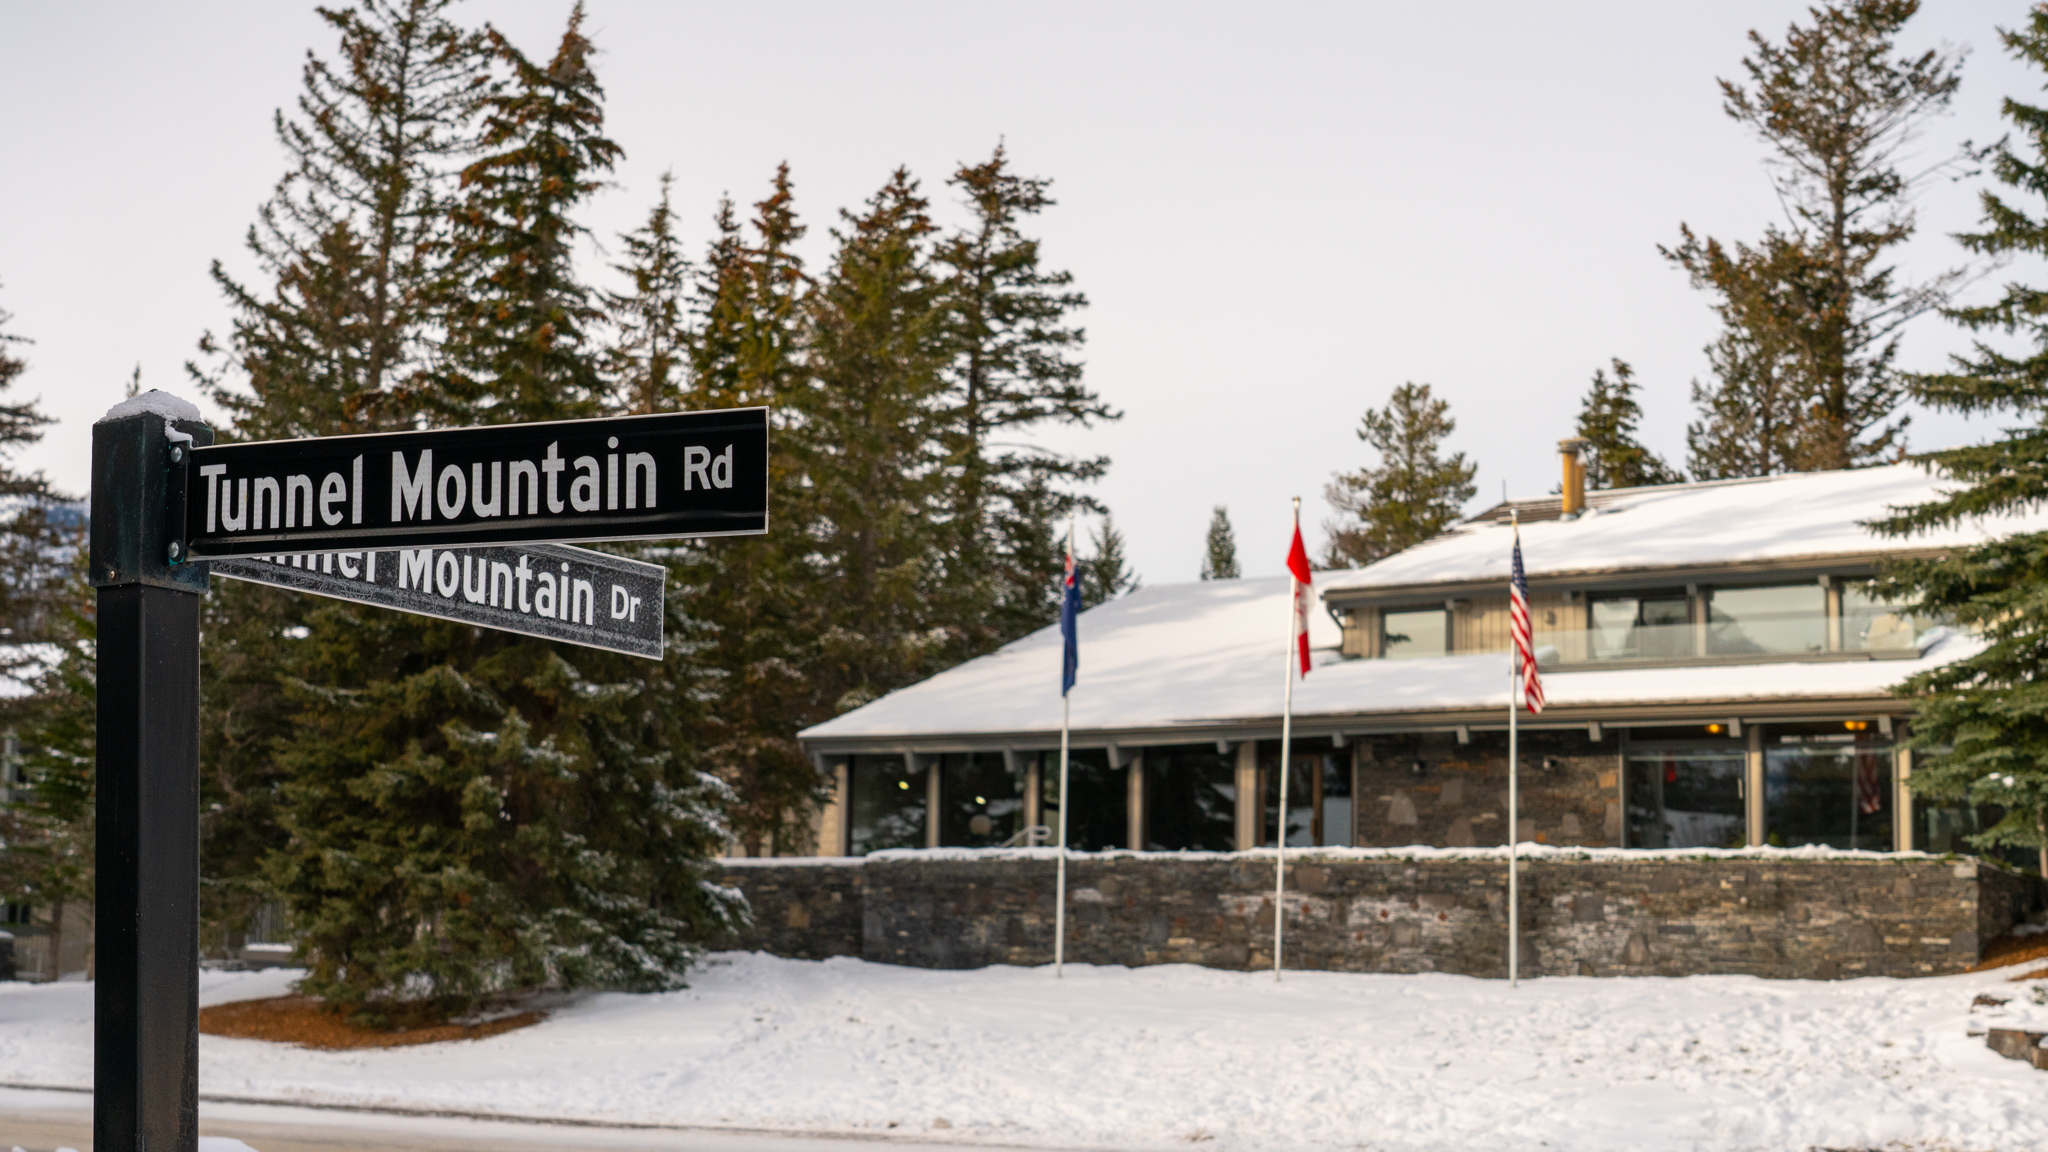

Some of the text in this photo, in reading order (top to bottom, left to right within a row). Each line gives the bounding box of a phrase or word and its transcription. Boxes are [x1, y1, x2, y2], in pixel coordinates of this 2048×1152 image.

[200, 436, 733, 533] Tunnel Mountain Rd
[398, 549, 594, 626] Mountain
[611, 584, 641, 623] Dr
